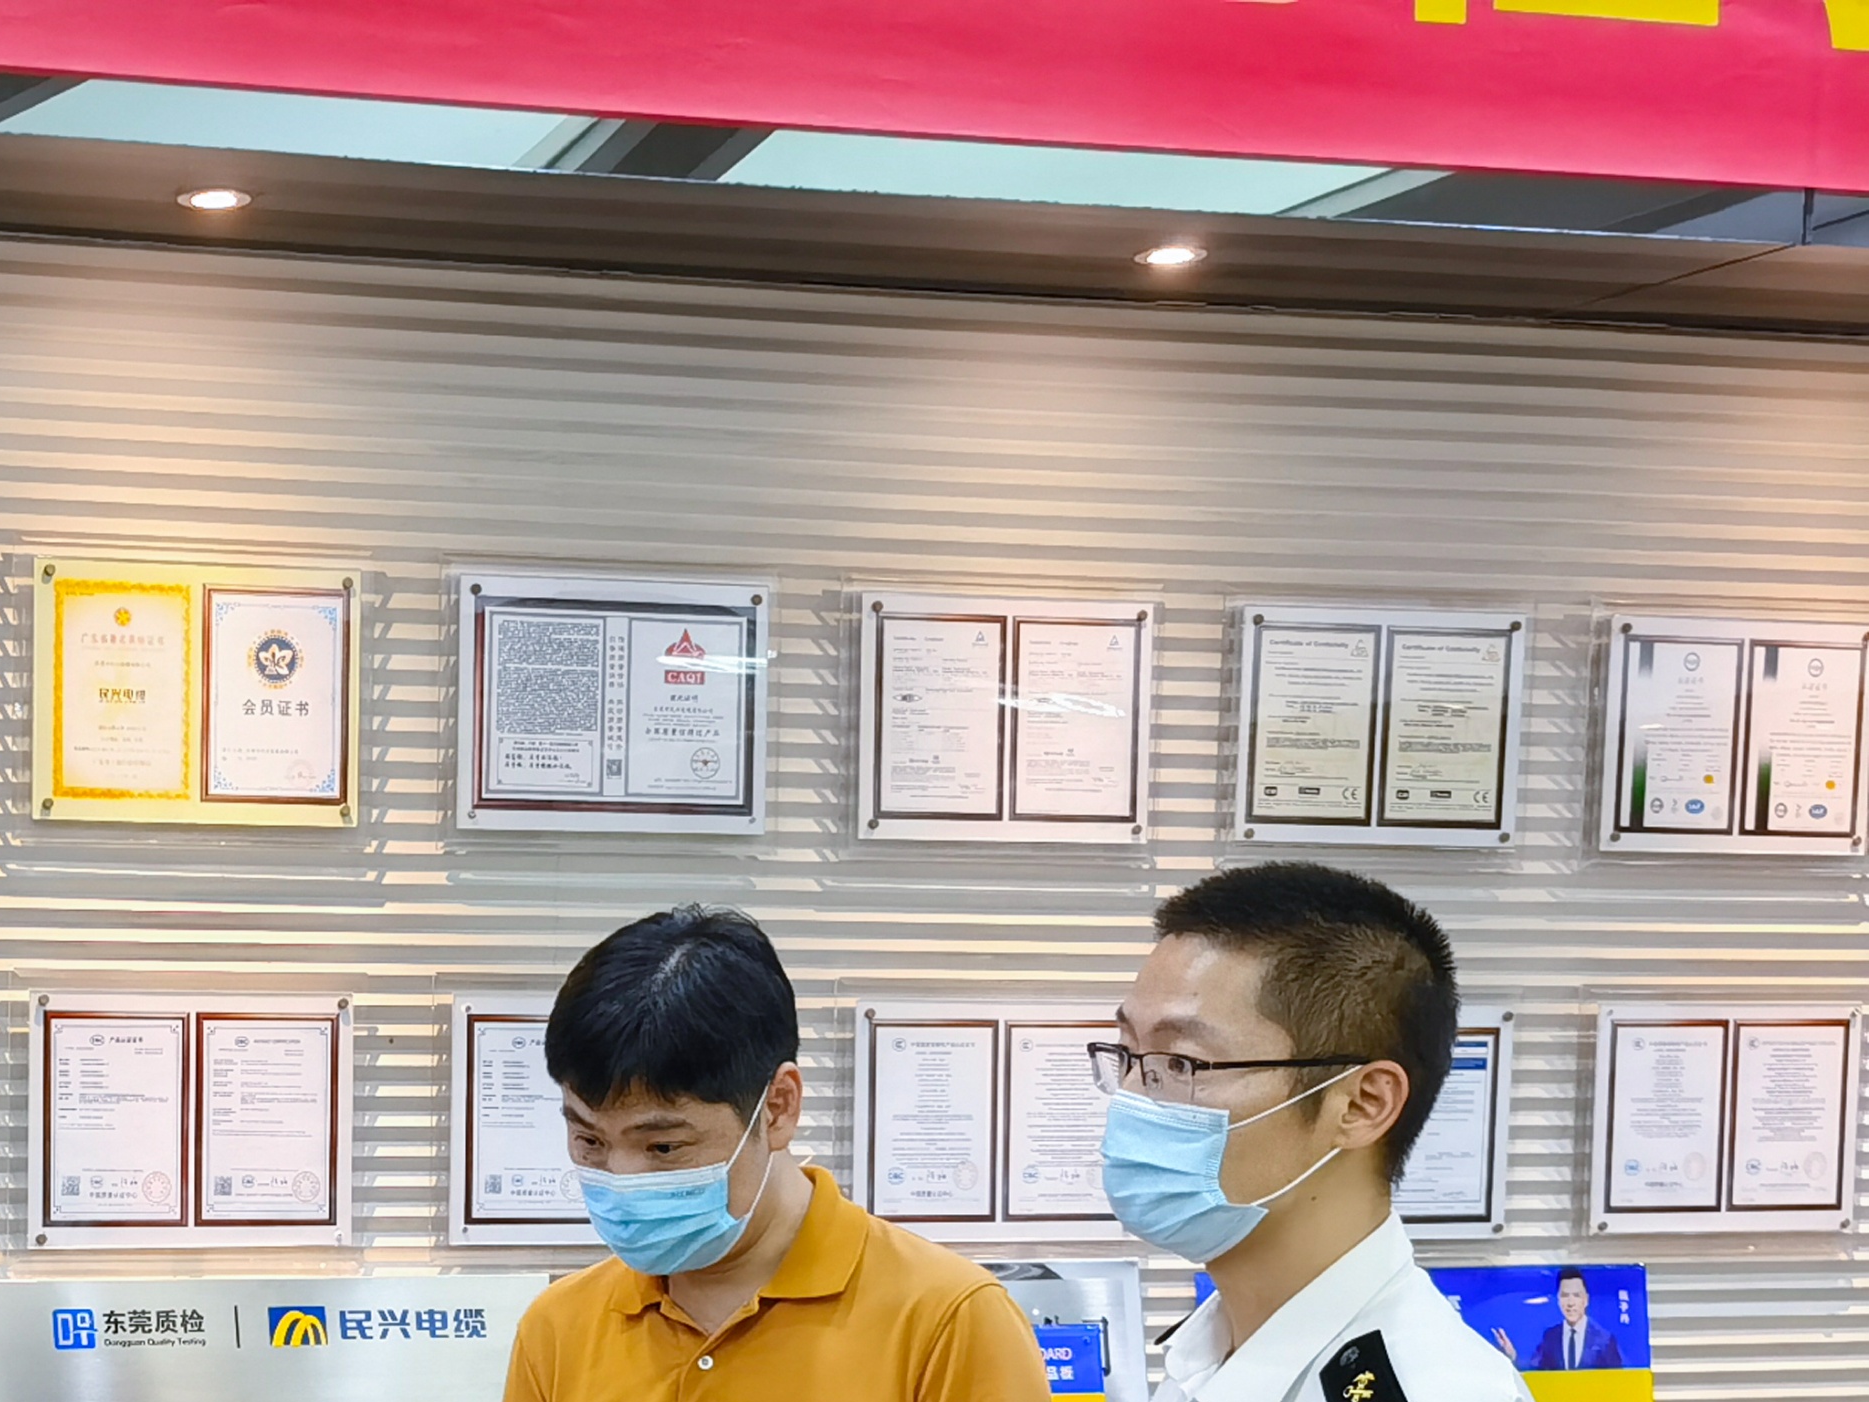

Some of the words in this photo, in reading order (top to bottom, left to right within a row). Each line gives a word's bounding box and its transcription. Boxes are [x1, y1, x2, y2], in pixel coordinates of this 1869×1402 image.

[666, 671, 703, 684] CAQI
[242, 699, 309, 716] 会员证书
[102, 1309, 205, 1334] 东莞质检
[339, 1309, 487, 1339] 民兴电缆
[103, 1338, 146, 1347] Dongguan
[147, 1338, 175, 1347] Quality
[178, 1337, 207, 1347] Testing
